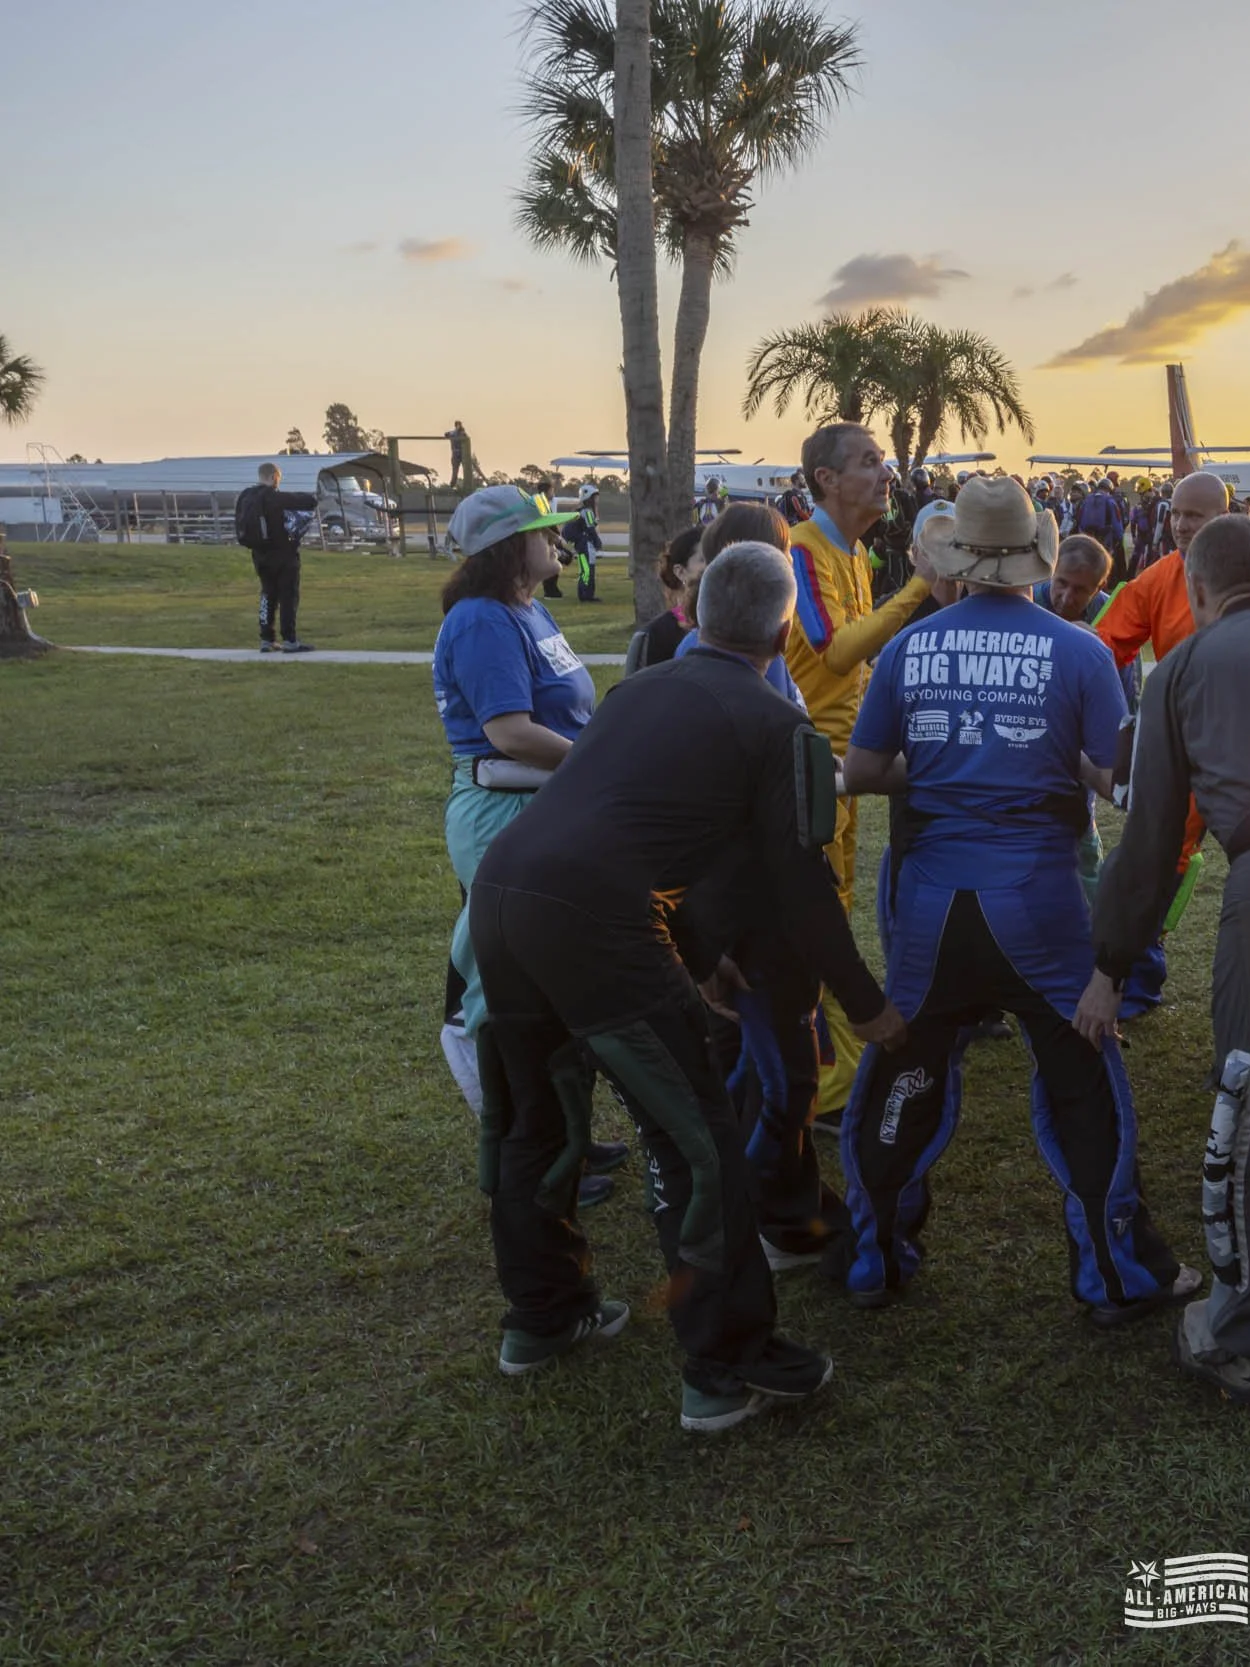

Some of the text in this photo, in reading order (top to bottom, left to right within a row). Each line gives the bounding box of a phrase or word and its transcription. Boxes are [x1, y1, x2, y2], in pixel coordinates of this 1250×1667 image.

[906, 629, 1053, 658] ALL AMERICAN
[904, 653, 949, 687] BIG
[904, 688, 1047, 707] SKYDIVING COMPANY
[1028, 716, 1048, 727] EYE
